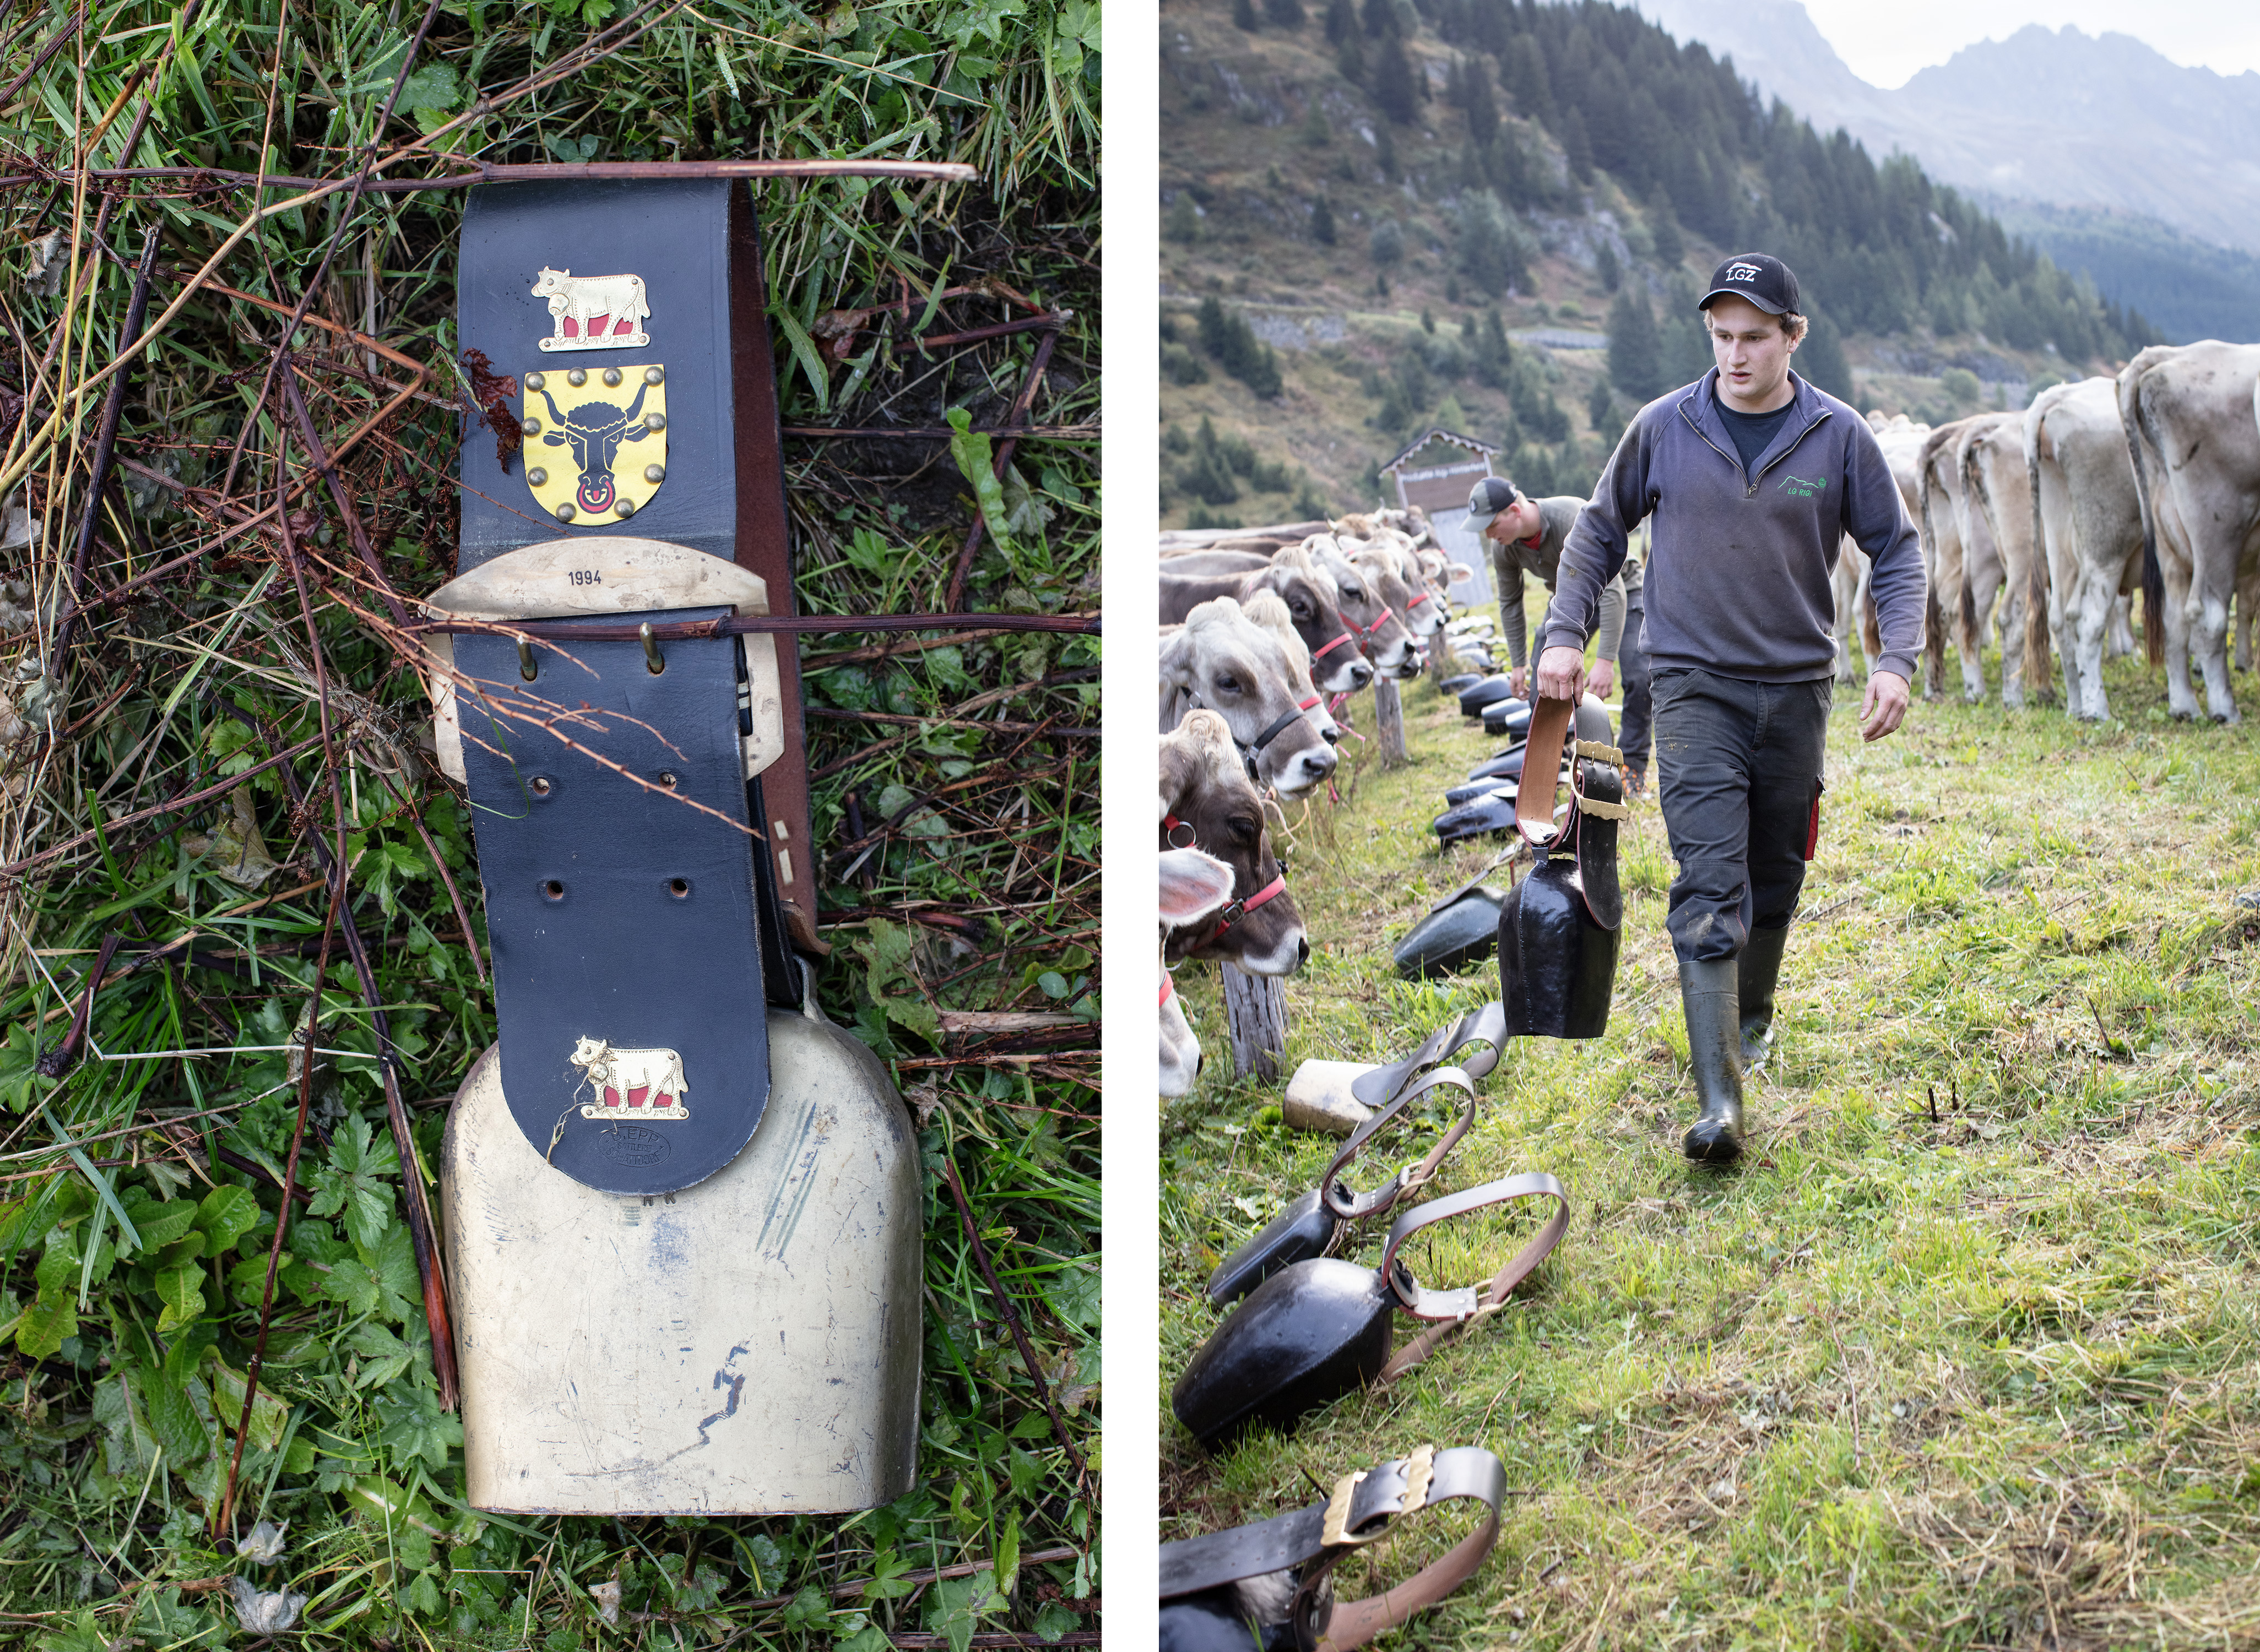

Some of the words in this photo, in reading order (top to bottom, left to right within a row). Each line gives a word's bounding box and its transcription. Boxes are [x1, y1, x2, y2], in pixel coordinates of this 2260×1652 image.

[1725, 268, 1757, 282] LGZ
[1798, 488, 1813, 497] RIGI
[568, 570, 601, 586] 1994
[605, 1146, 661, 1165] SCHATTDORF
